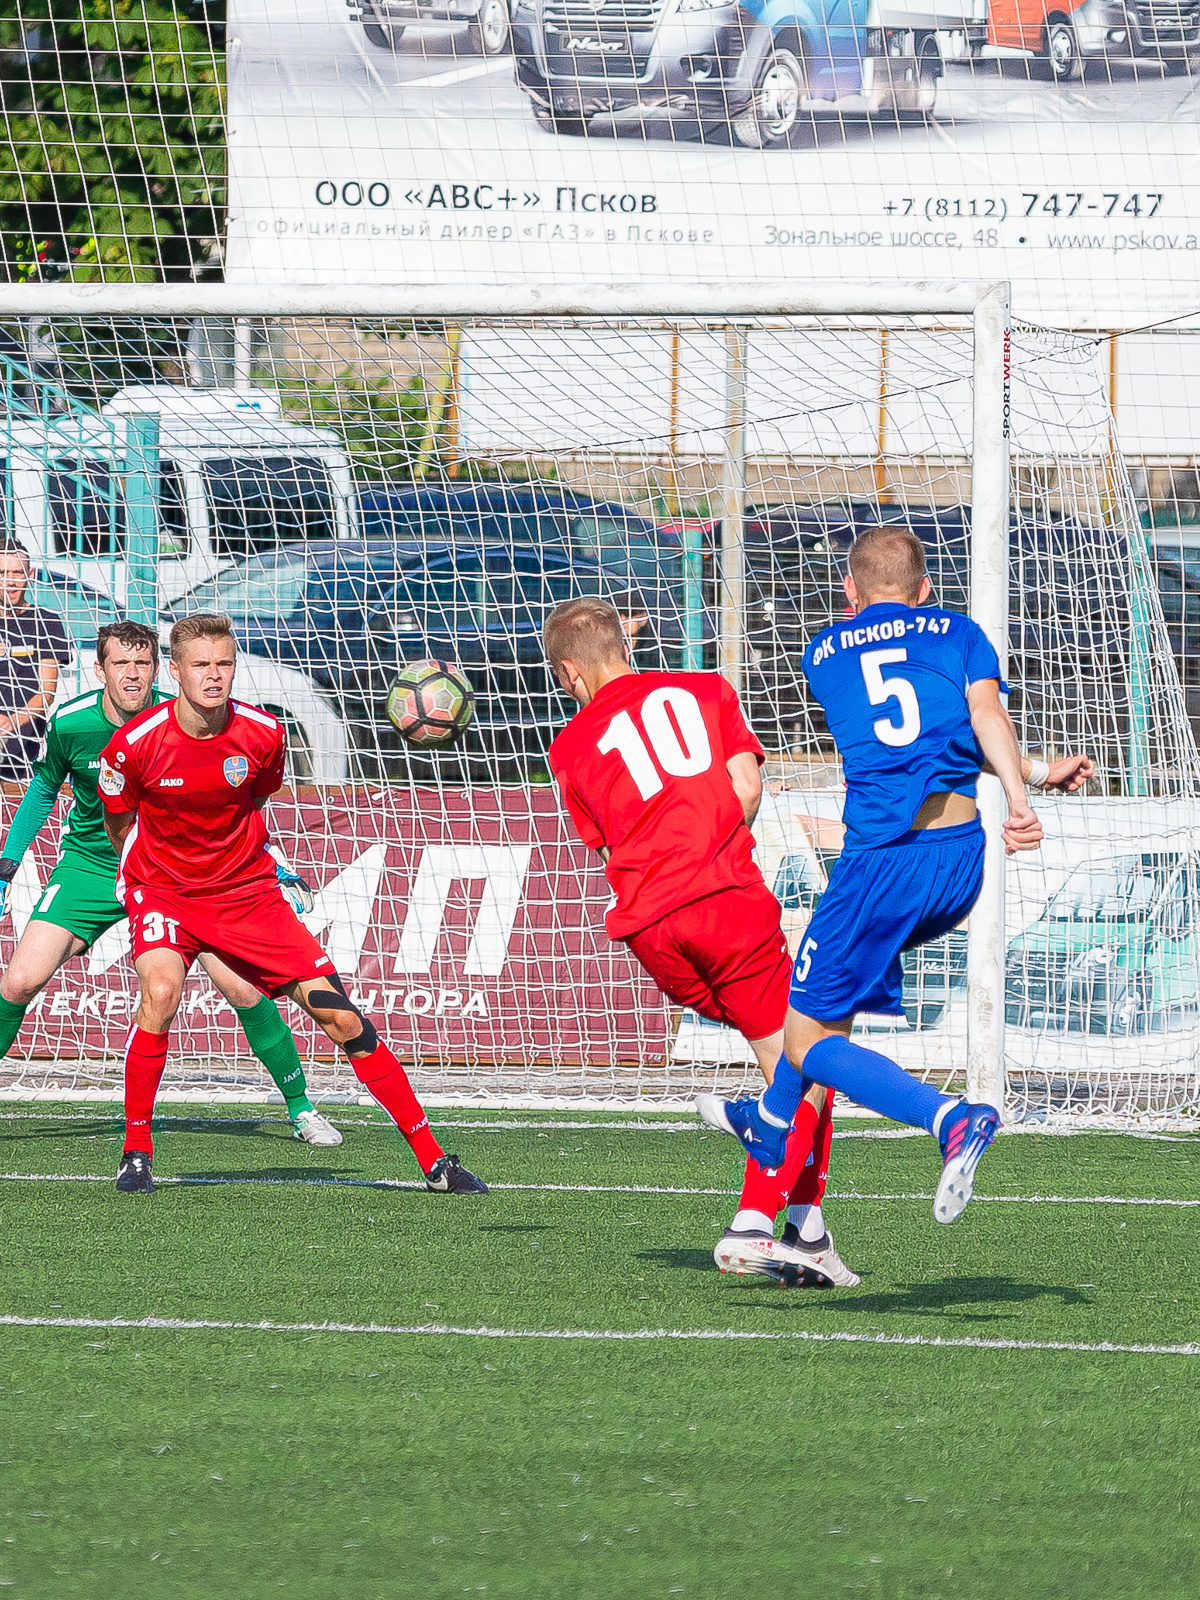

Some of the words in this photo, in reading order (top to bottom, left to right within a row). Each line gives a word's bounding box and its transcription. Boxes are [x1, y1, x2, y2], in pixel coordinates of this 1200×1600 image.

[315, 180, 391, 207] ООО
[404, 183, 541, 210] «АВС+»
[556, 186, 659, 213] Псков
[882, 198, 916, 217] +7
[924, 197, 1008, 223] (8112)
[1022, 193, 1164, 217] 747-747
[257, 217, 431, 238] официальный
[441, 224, 513, 240] дилер
[522, 222, 596, 241] «ГАЗ»
[606, 229, 617, 241] в
[627, 225, 714, 243] Пскове
[764, 225, 883, 246] Зональное
[891, 231, 963, 251] шоссе,
[972, 228, 999, 247] 48
[1002, 329, 1012, 439] SPORTWERK
[840, 616, 951, 650] ПСКОВ-747
[860, 648, 922, 747] 5
[598, 686, 713, 802] 10
[88, 760, 101, 770] JA
[159, 777, 184, 788] JAKO
[37, 883, 62, 913] 1
[795, 934, 818, 982] 5
[282, 1067, 301, 1084] JAKO
